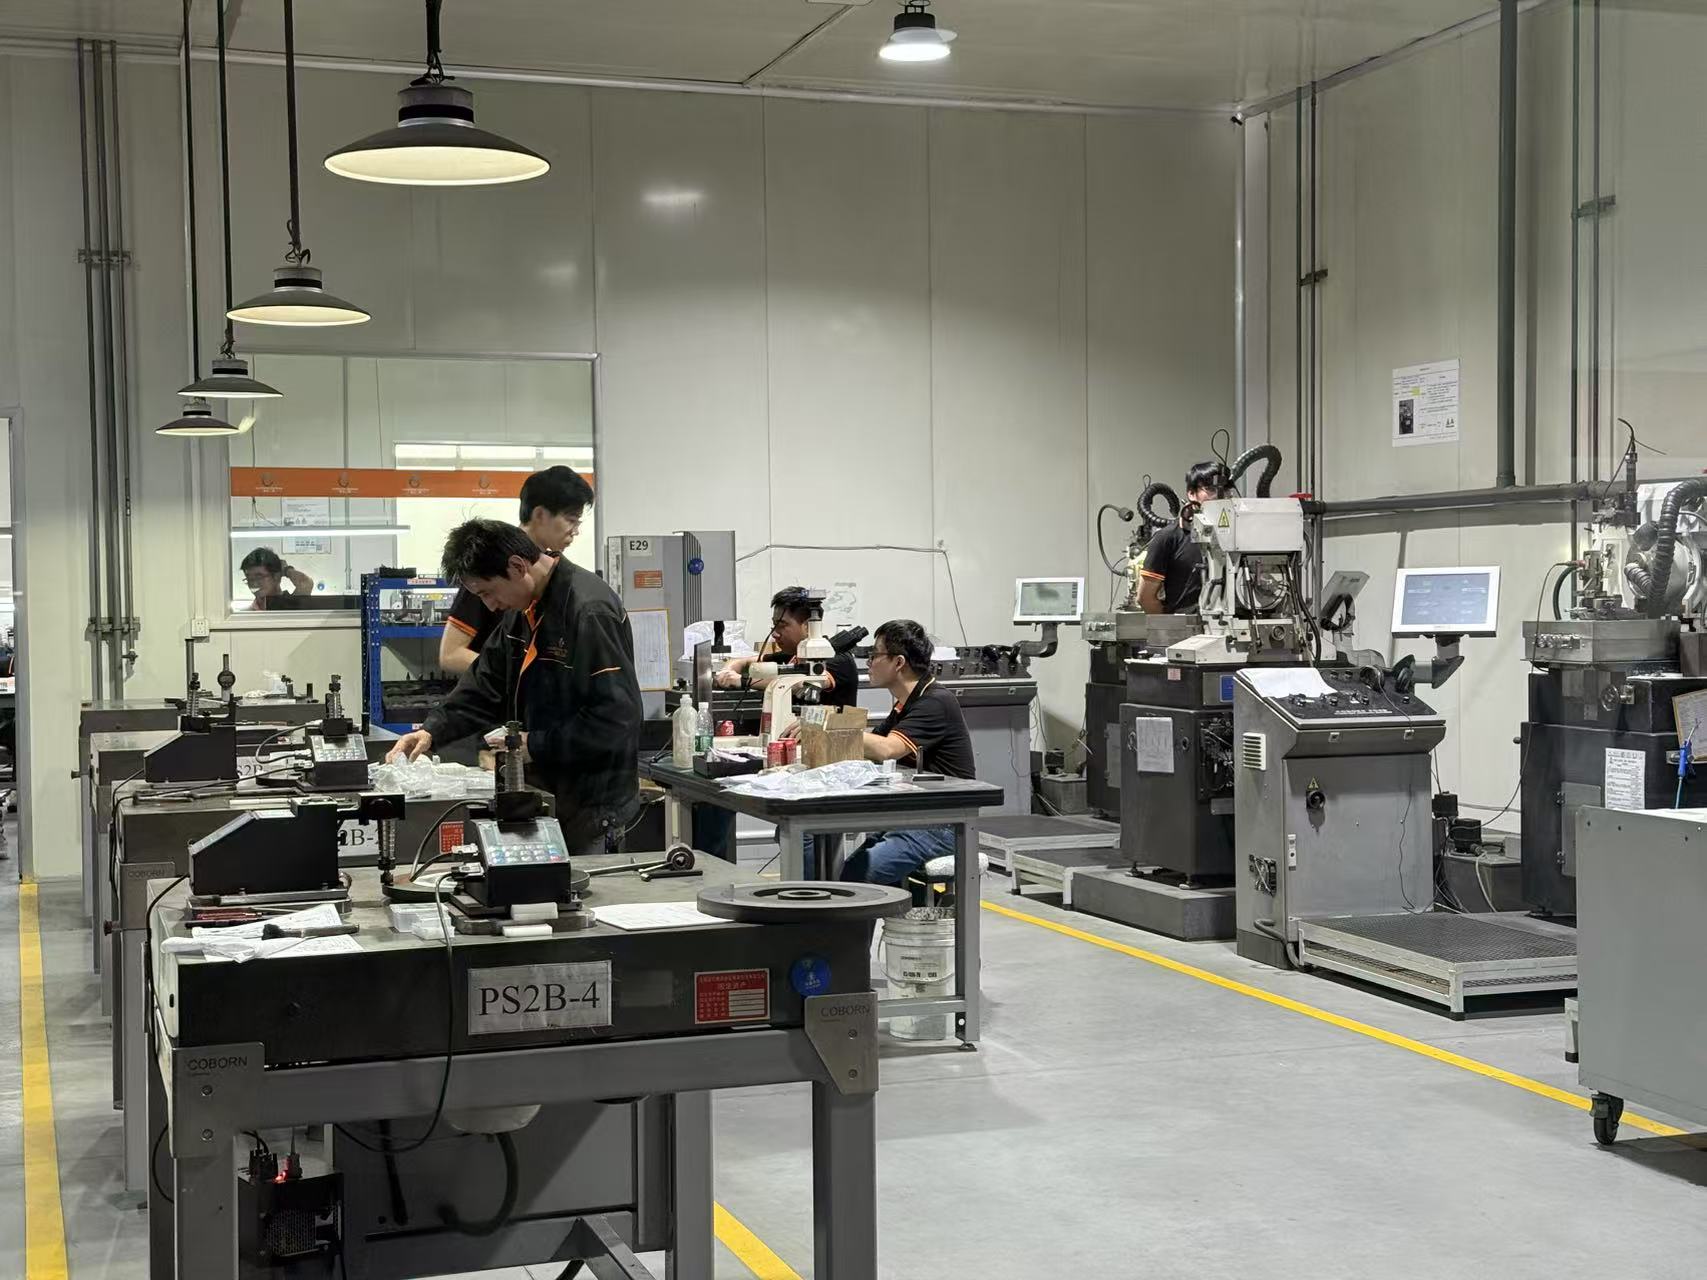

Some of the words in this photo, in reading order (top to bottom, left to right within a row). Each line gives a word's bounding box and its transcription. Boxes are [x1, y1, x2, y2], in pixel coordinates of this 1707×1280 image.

[629, 540, 649, 551] E29
[479, 981, 600, 1016] PS2B-4
[820, 1003, 871, 1018] COBORN
[187, 1055, 248, 1071] COBORN
